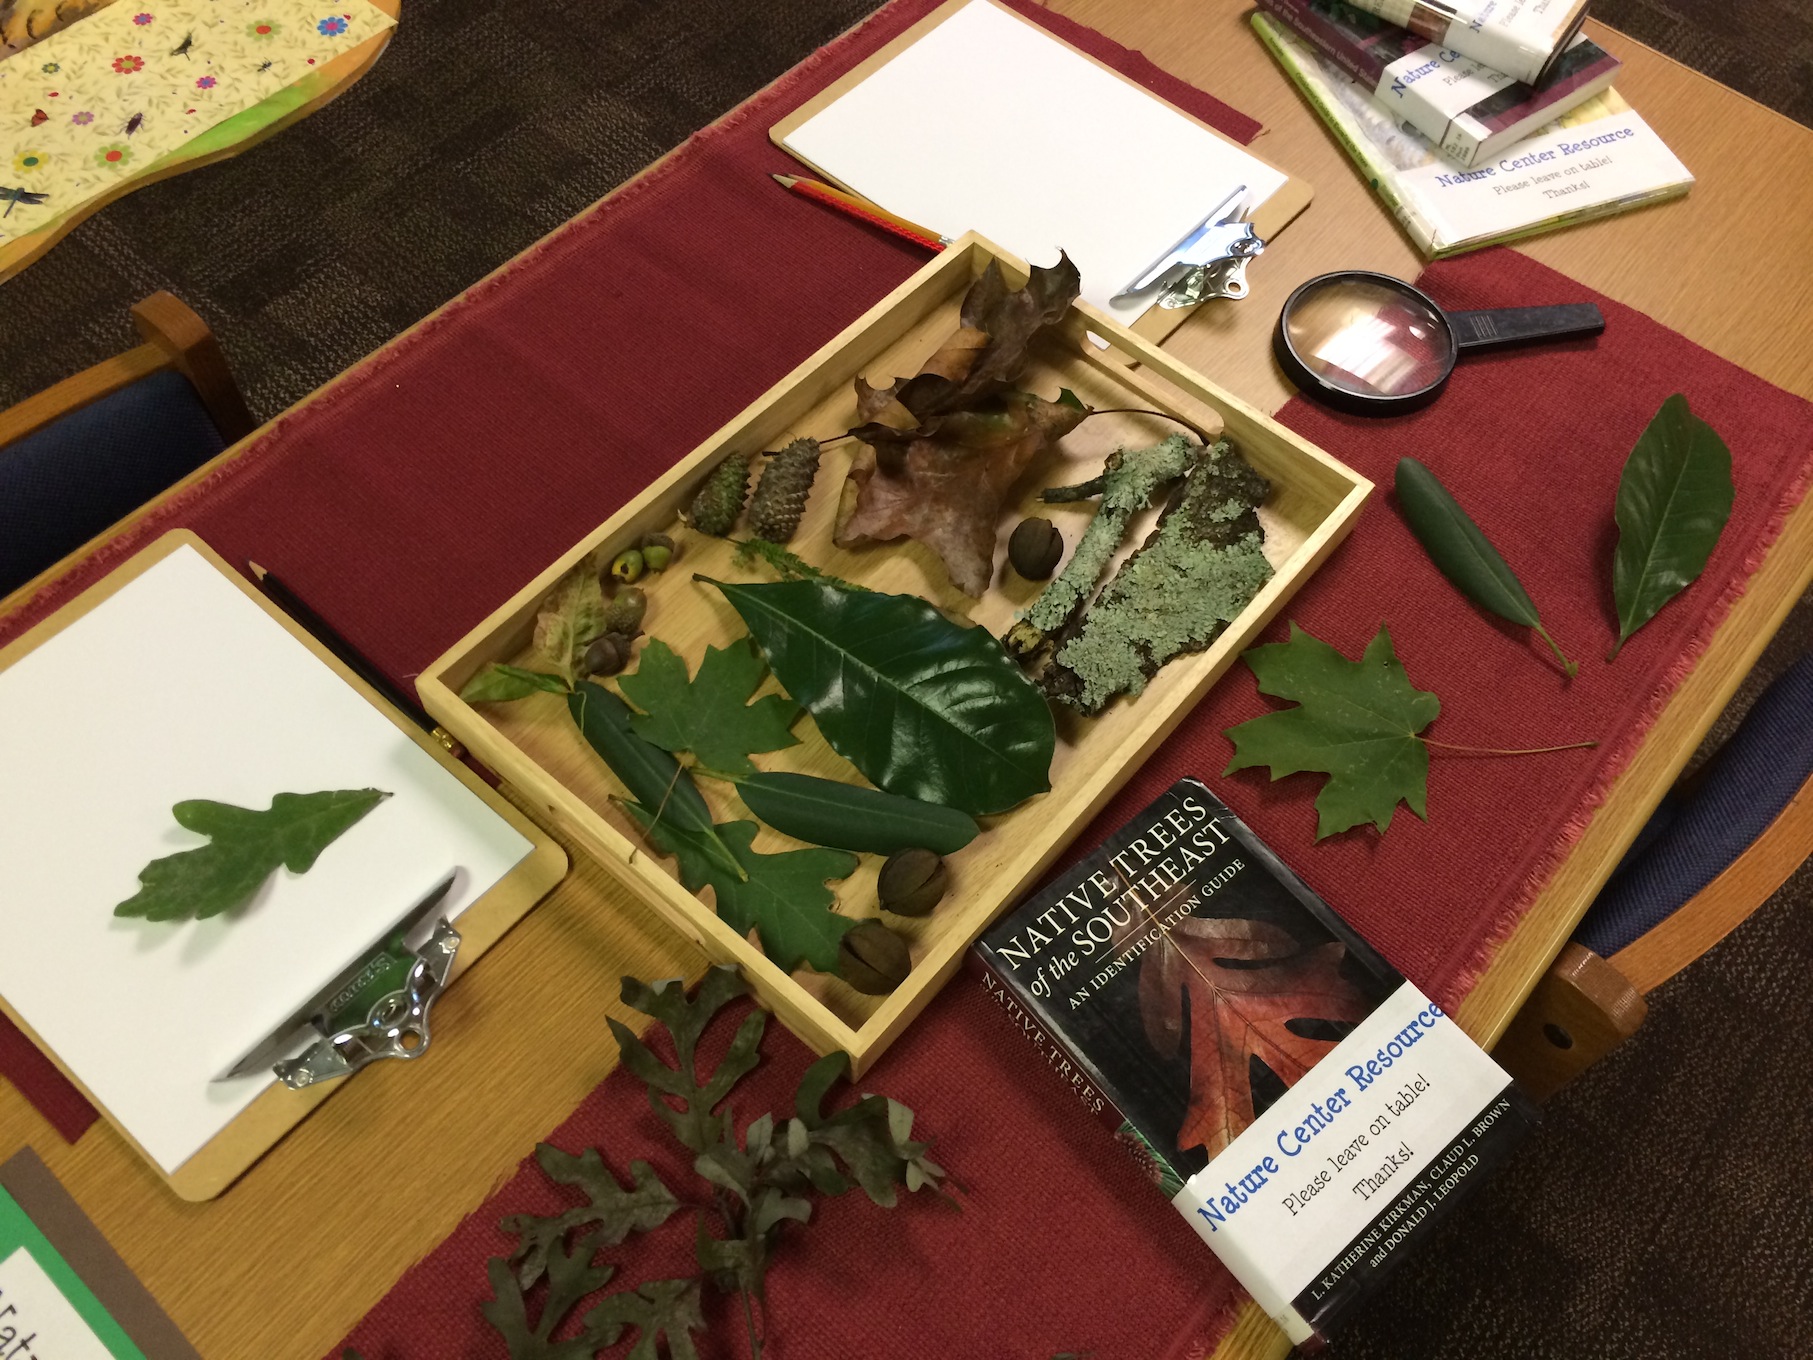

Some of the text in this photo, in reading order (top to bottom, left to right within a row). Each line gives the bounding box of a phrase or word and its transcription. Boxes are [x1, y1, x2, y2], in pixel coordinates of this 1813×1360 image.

[1391, 60, 1441, 98] Nature
[1442, 68, 1475, 86] Please
[1435, 126, 1635, 188] Nature Center Resource
[1492, 155, 1614, 195] Please leave on table!
[1542, 180, 1591, 199] Thanks!
[996, 796, 1207, 971] NATIVE TREES
[1030, 817, 1231, 998] of the SOUTHEAST
[1068, 858, 1246, 1010] AN IDENTIFICATION GUIDE
[982, 971, 1046, 1047] NATIVE
[1050, 1045, 1105, 1112] TREES
[1197, 1001, 1446, 1232] Nature Center Resource
[1281, 1073, 1431, 1217] Please leave on table!
[1352, 1141, 1415, 1201] Thanks!
[1311, 1097, 1511, 1301] L. KATHERINE KIRKMAN, CLAUD L. BROWN
[1369, 1153, 1480, 1268] and DONALD J. LEOPOLD
